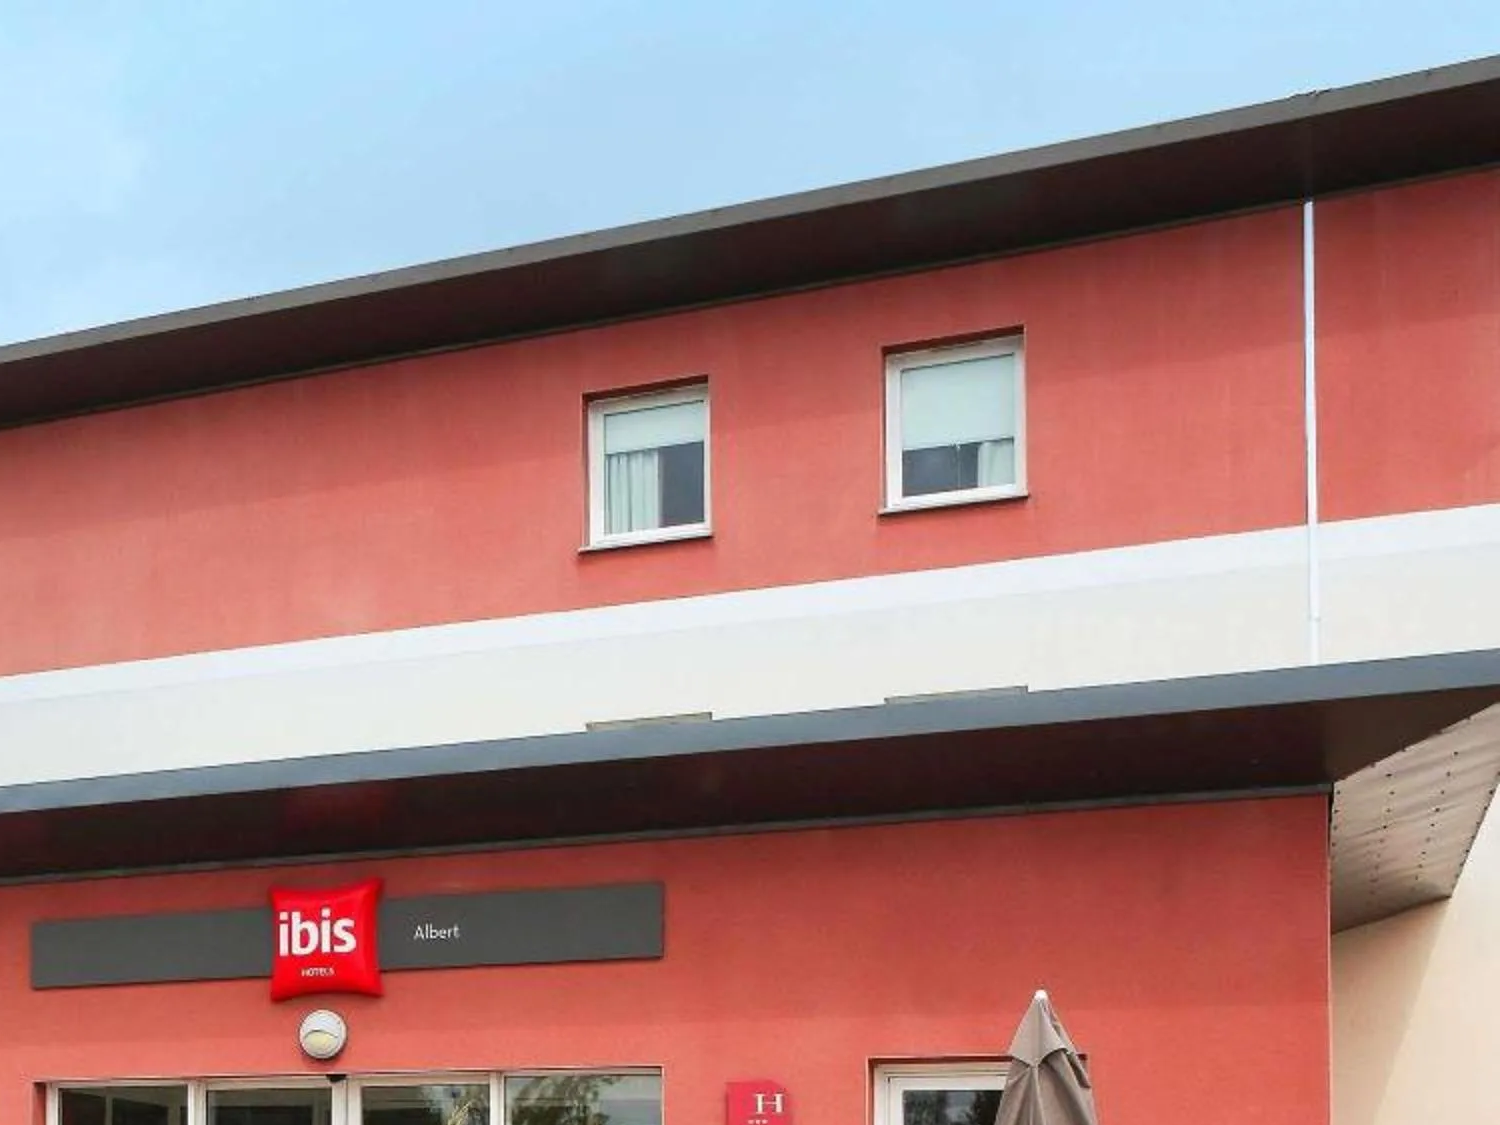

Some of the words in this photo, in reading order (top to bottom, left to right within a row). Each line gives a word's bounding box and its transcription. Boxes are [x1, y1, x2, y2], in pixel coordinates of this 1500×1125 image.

[279, 907, 357, 957] ibis
[413, 923, 461, 940] Albert
[301, 967, 336, 977] HOTELS
[754, 1093, 784, 1115] H
